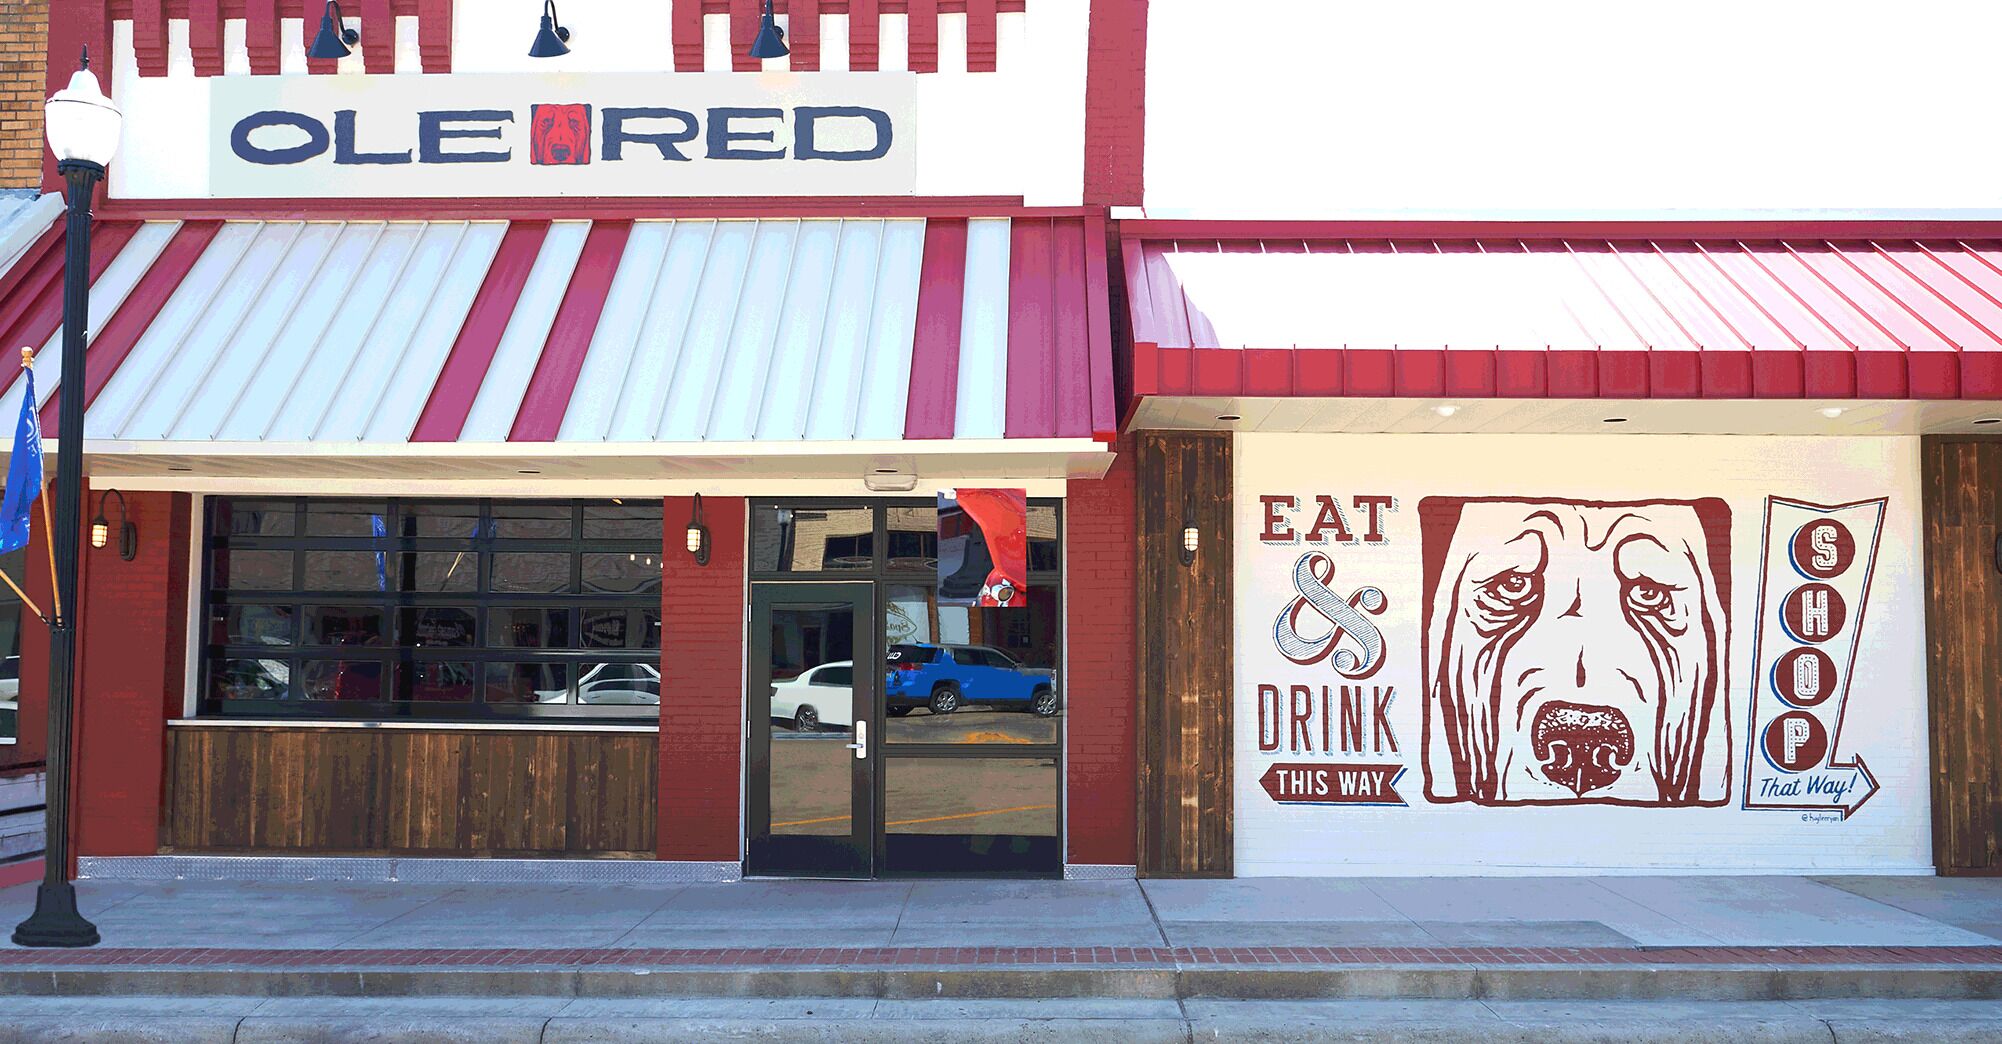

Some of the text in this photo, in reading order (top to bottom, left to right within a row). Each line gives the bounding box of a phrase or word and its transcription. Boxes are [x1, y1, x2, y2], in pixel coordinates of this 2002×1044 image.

[230, 106, 893, 165] OLE RED
[1259, 494, 1398, 546] EAT
[1272, 550, 1389, 680] &
[1782, 524, 1839, 765] SHOP
[1258, 684, 1401, 757] DRINK
[1275, 770, 1385, 797] THIS WAY
[1760, 772, 1858, 804] That Way!
